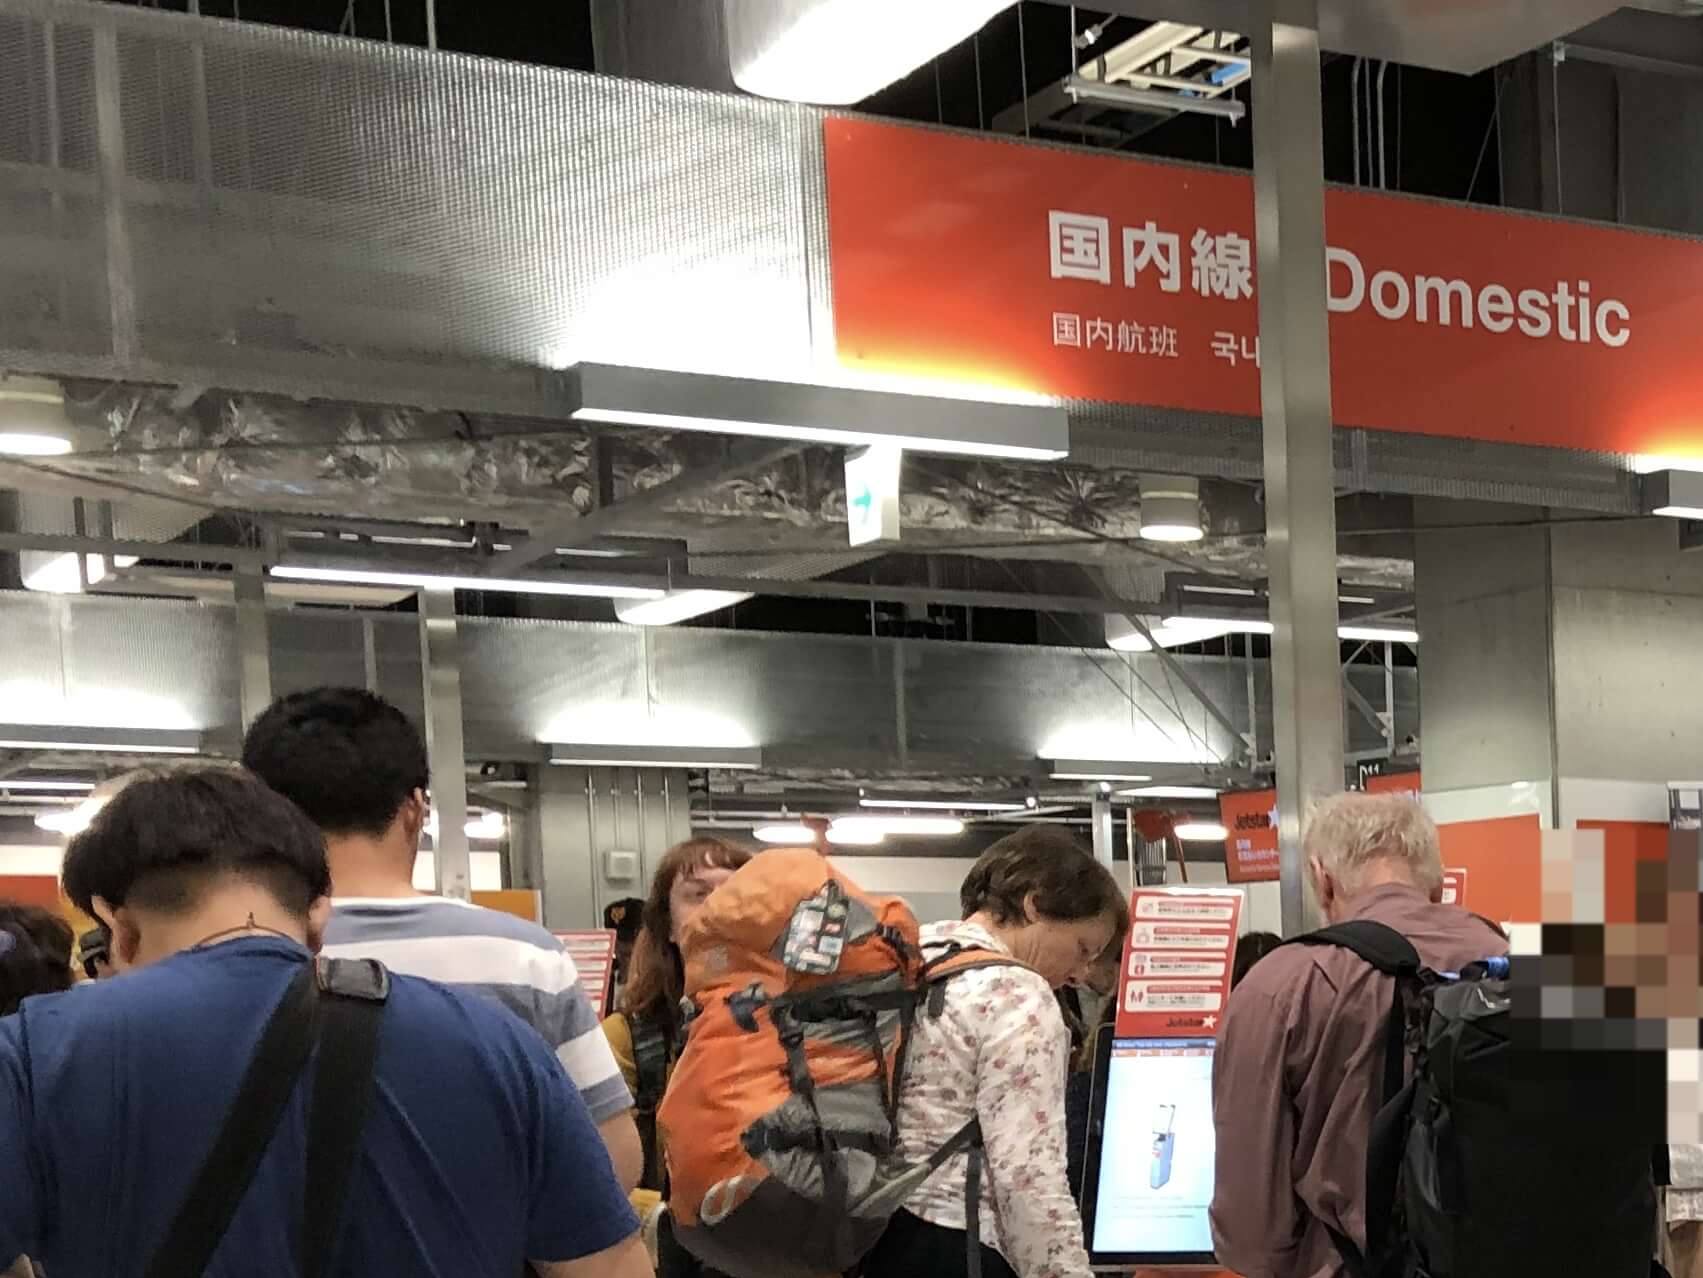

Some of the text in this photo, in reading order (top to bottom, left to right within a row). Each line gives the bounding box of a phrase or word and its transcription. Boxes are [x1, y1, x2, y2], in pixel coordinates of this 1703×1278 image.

[1049, 210, 1254, 299] 国内線
[1326, 246, 1630, 347] Domestic
[1053, 311, 1179, 358] 国内航班
